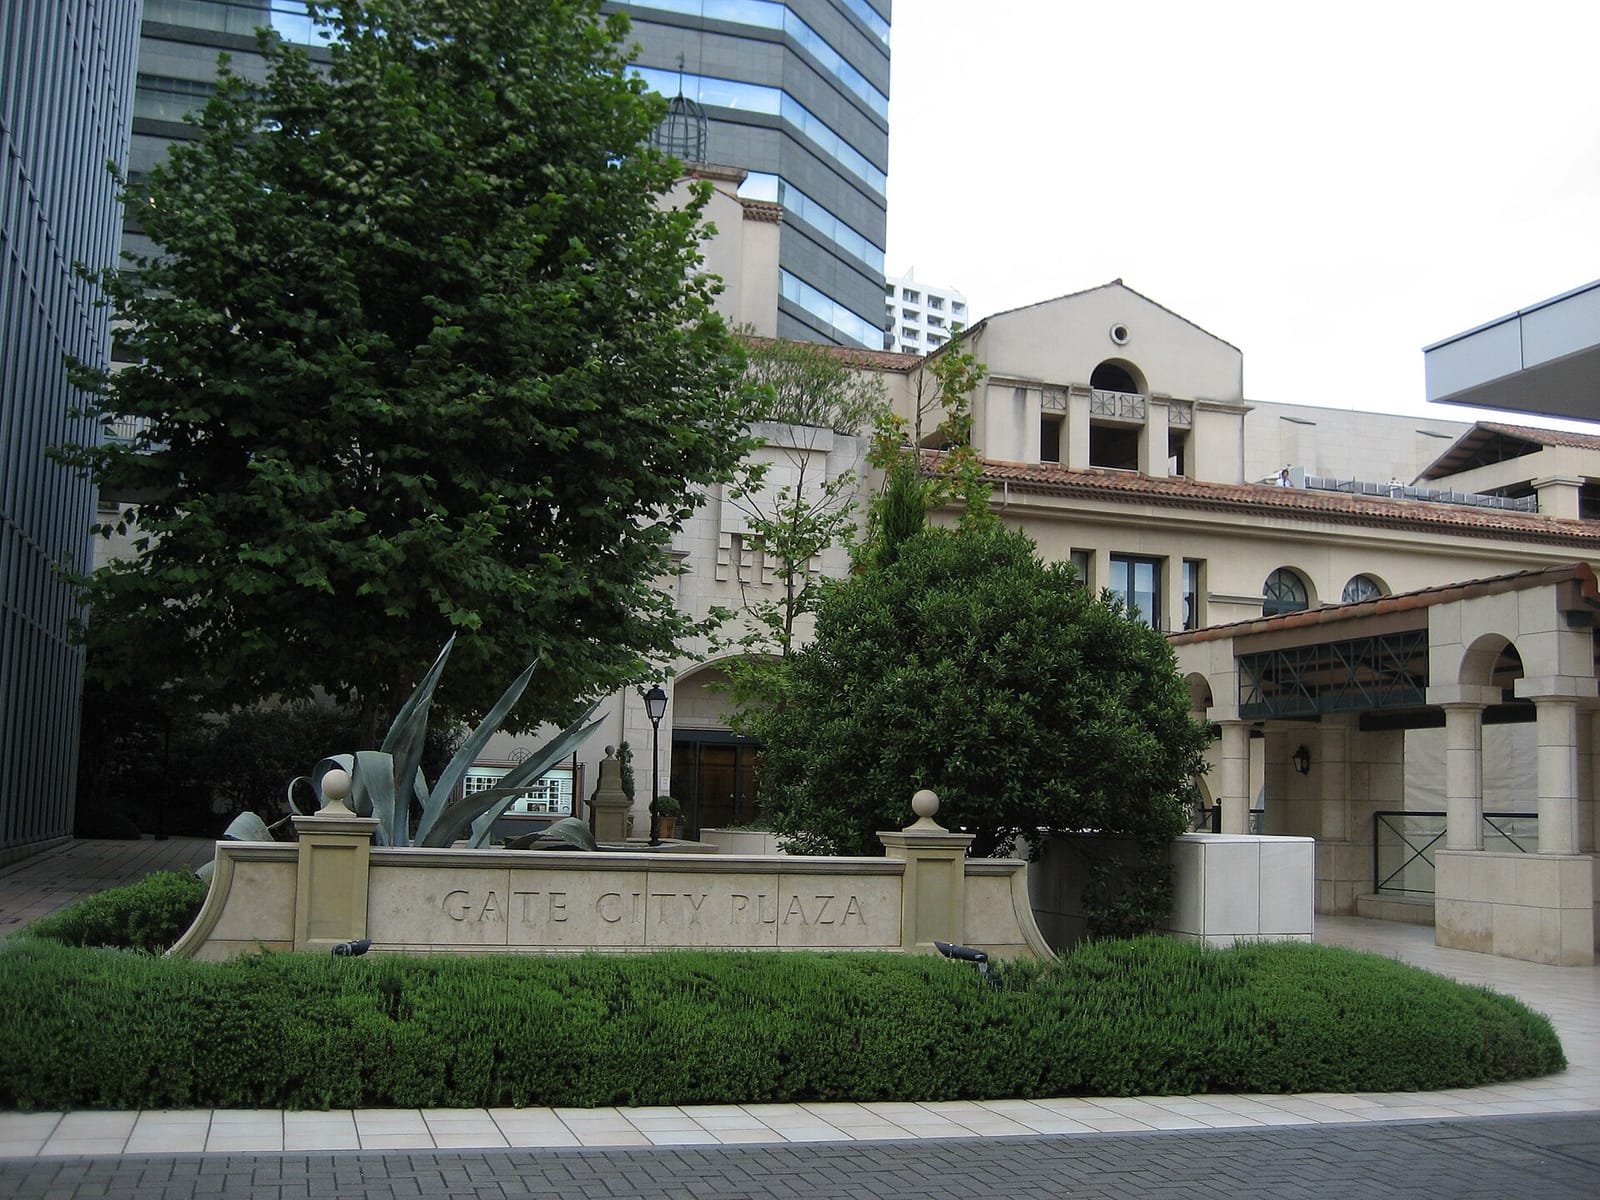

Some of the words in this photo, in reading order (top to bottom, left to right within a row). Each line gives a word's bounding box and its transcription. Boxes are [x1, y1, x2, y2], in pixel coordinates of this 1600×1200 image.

[442, 889, 569, 923] GATE
[595, 892, 709, 925] CITY
[730, 894, 868, 926] PLAZA
